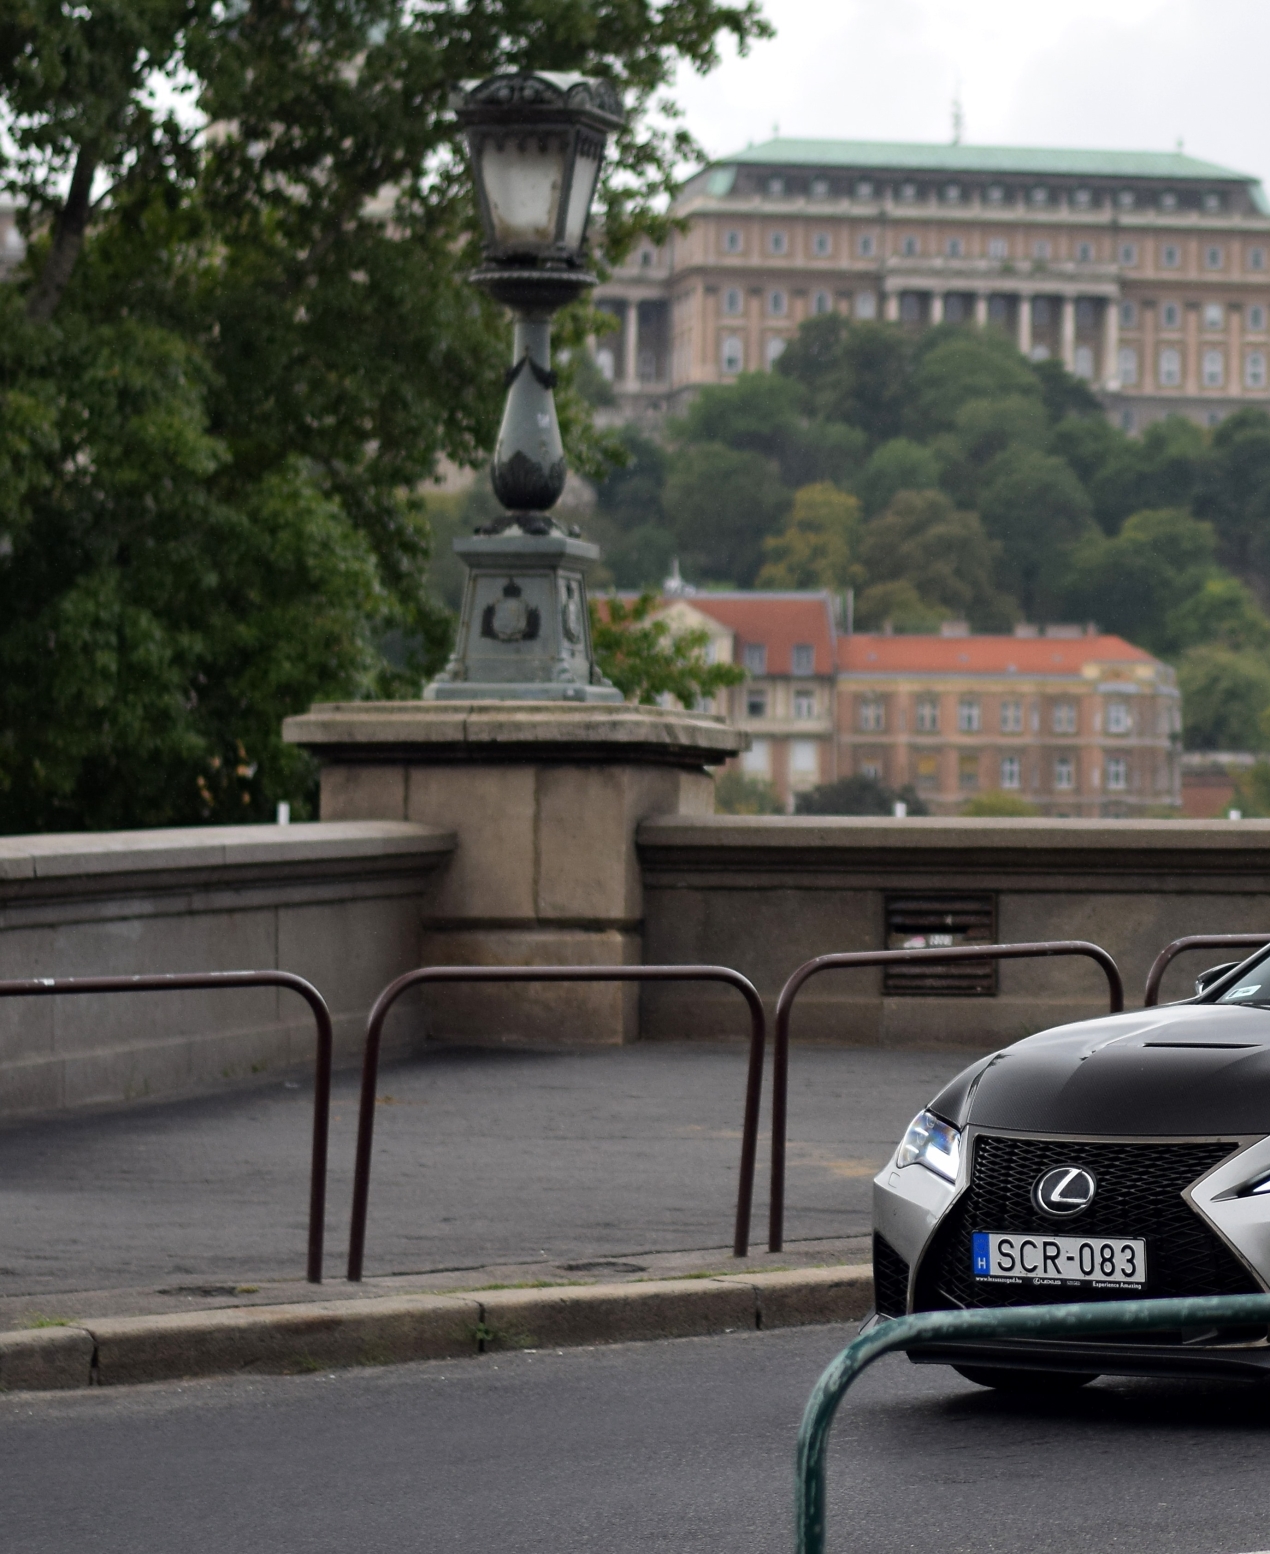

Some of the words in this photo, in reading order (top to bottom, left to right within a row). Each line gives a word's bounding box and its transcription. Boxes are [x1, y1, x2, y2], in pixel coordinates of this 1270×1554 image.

[978, 1257, 986, 1269] H
[997, 1238, 1136, 1278] SCR-083
[1120, 1282, 1141, 1290] Amazing
